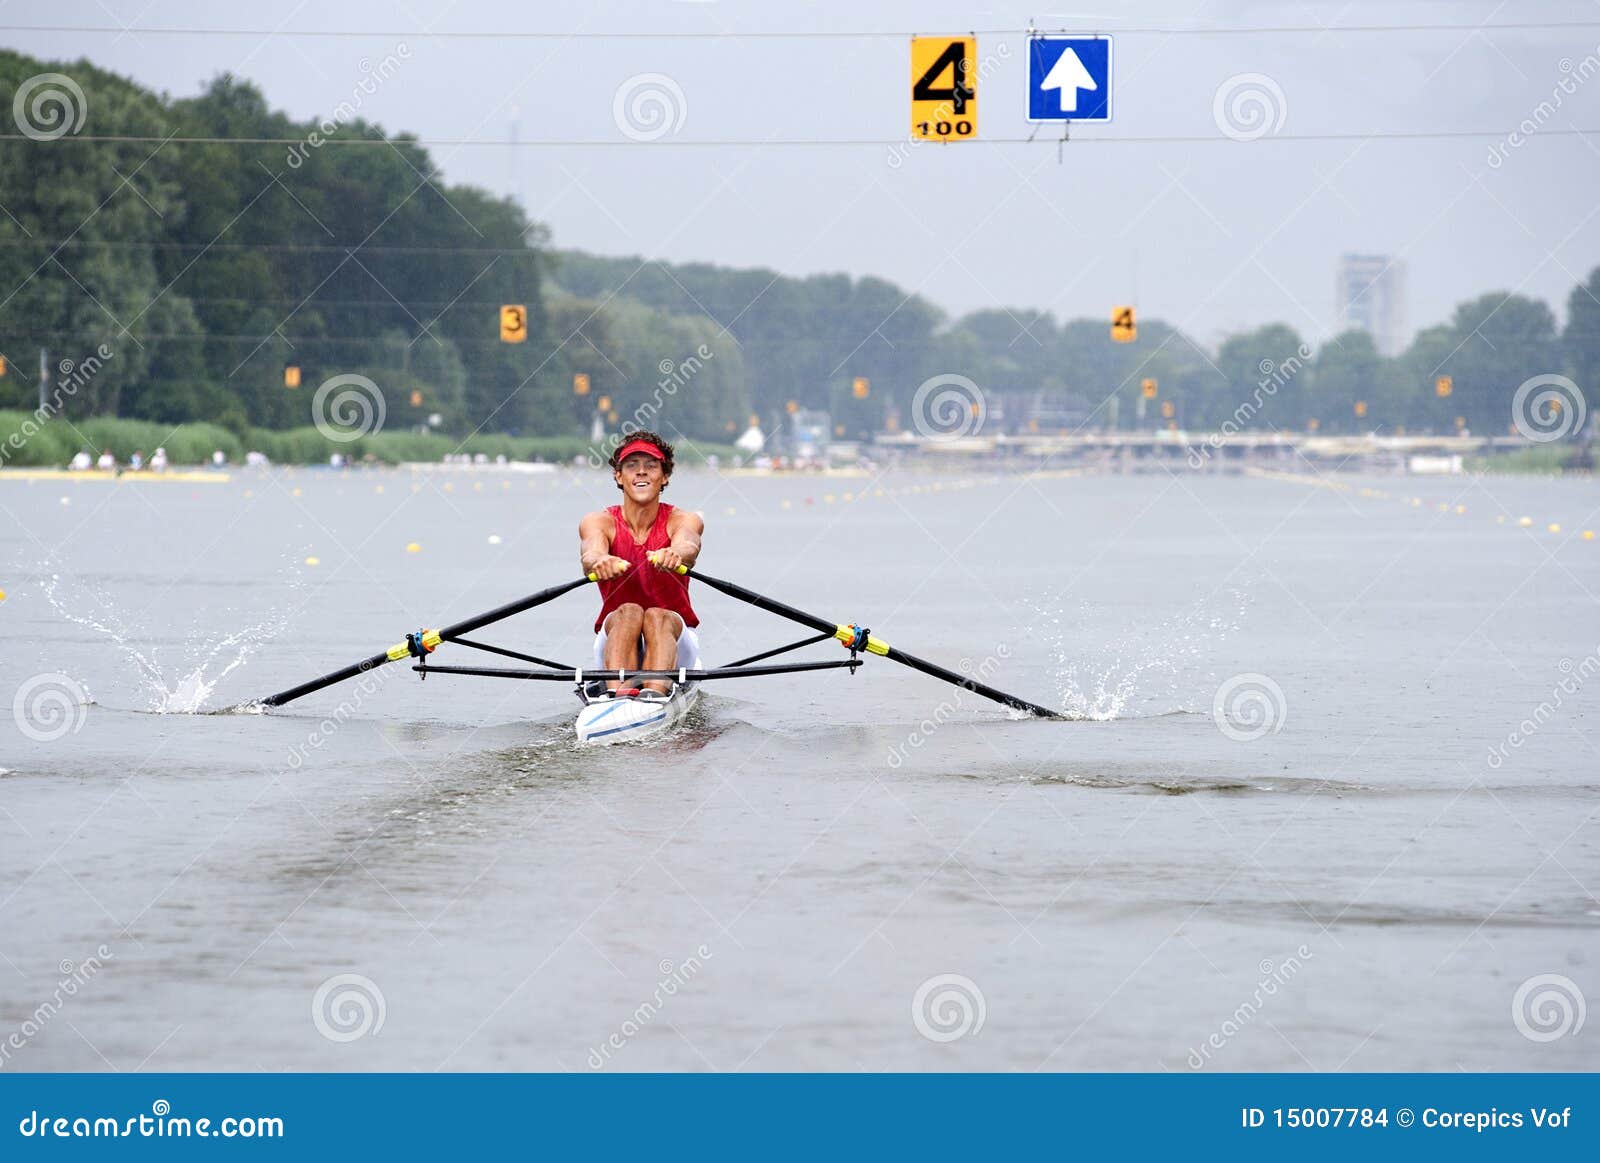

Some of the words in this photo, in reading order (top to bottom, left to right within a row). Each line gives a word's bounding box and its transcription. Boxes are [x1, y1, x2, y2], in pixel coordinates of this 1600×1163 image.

[913, 42, 974, 115] 4
[916, 121, 973, 135] 100
[502, 308, 522, 332] 3
[1113, 308, 1133, 331] 4
